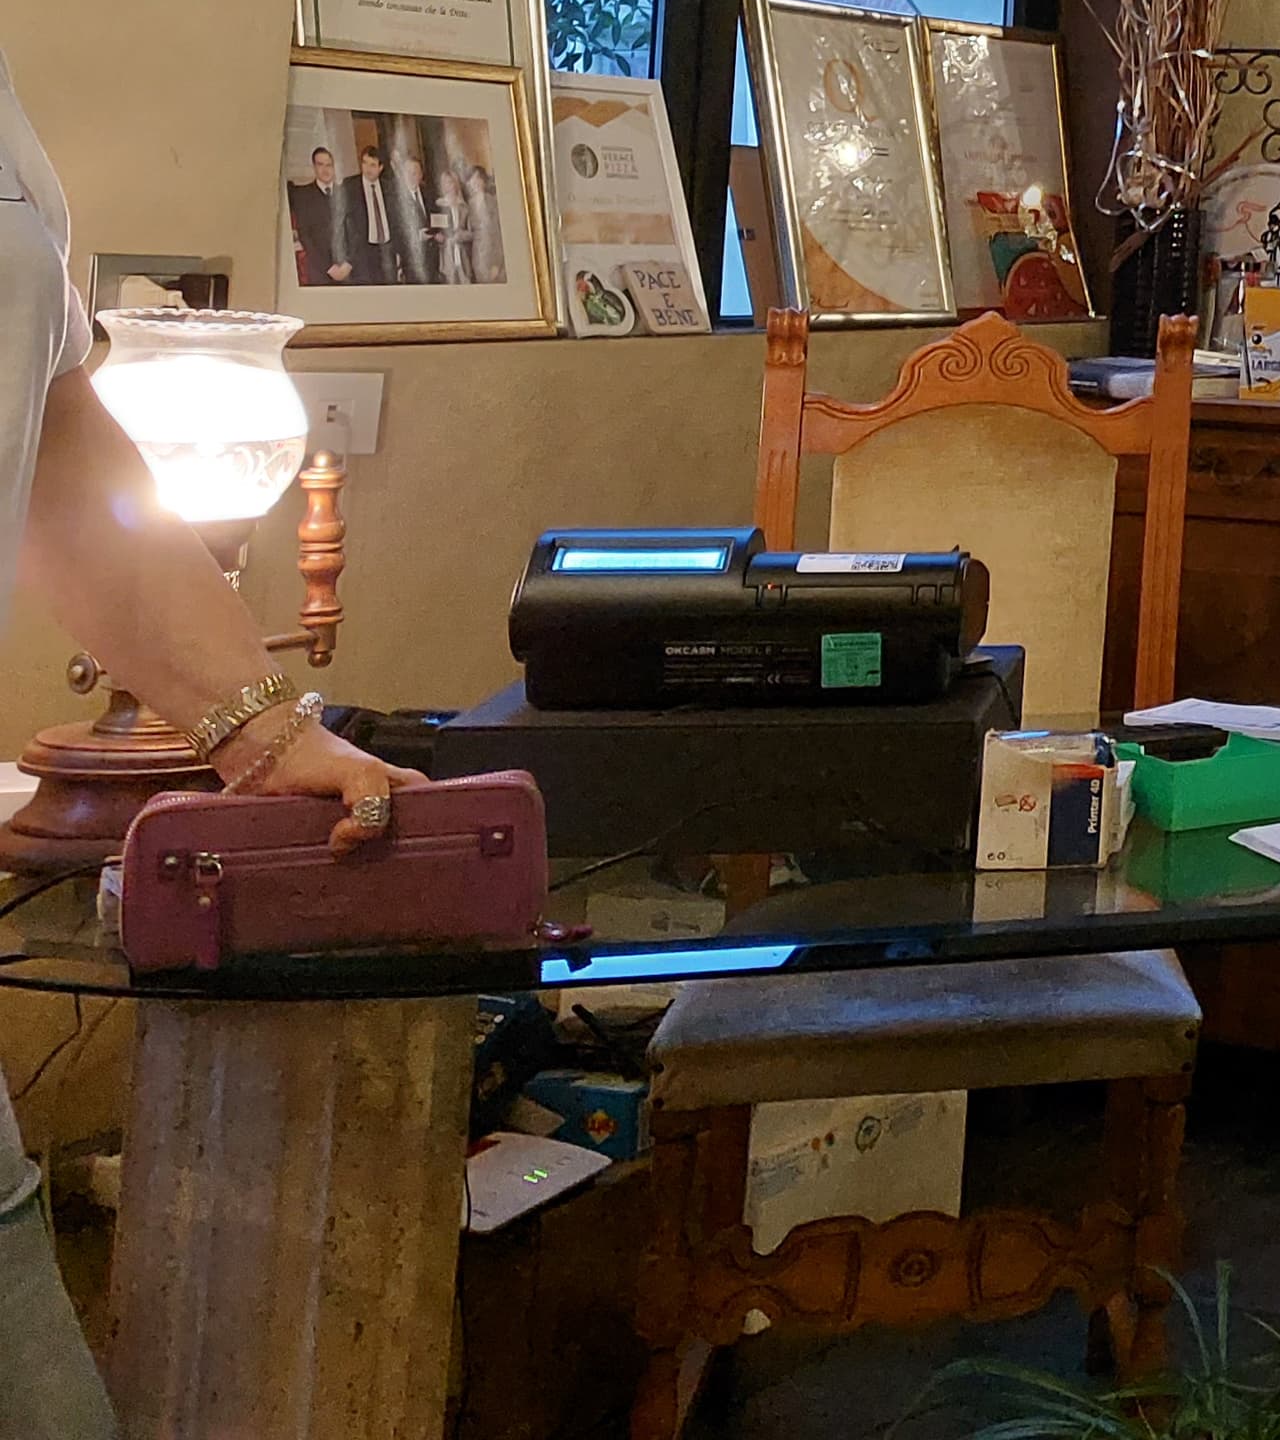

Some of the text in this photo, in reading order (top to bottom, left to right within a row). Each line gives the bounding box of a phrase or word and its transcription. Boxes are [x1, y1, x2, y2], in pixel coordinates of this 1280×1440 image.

[633, 269, 681, 290] PACE
[663, 293, 675, 309] E
[651, 308, 699, 327] BENE
[1087, 796, 1100, 833] Printer
